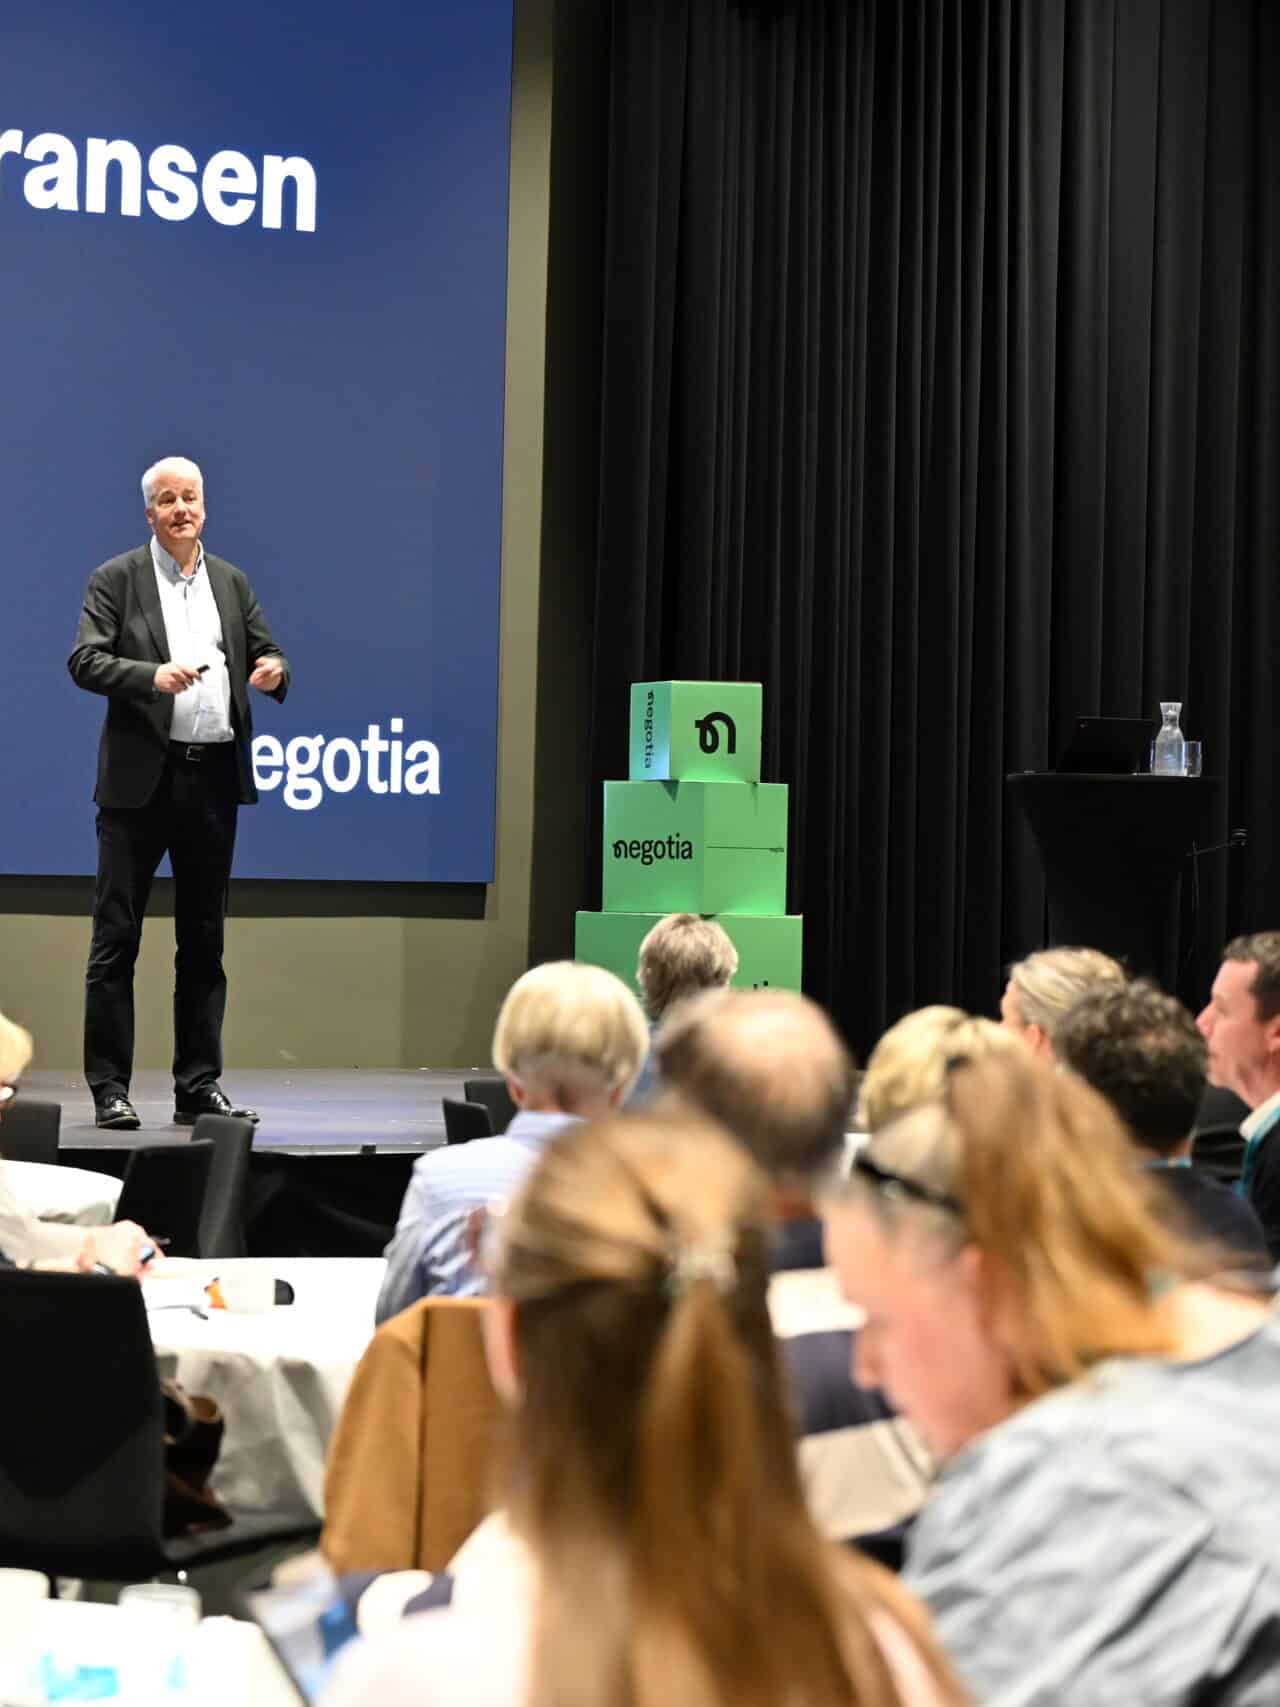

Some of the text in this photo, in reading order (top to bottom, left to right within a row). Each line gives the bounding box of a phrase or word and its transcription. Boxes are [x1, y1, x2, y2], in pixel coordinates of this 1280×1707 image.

[251, 717, 441, 811] egotia
[644, 689, 656, 769] negotia
[612, 832, 694, 866] negotia
